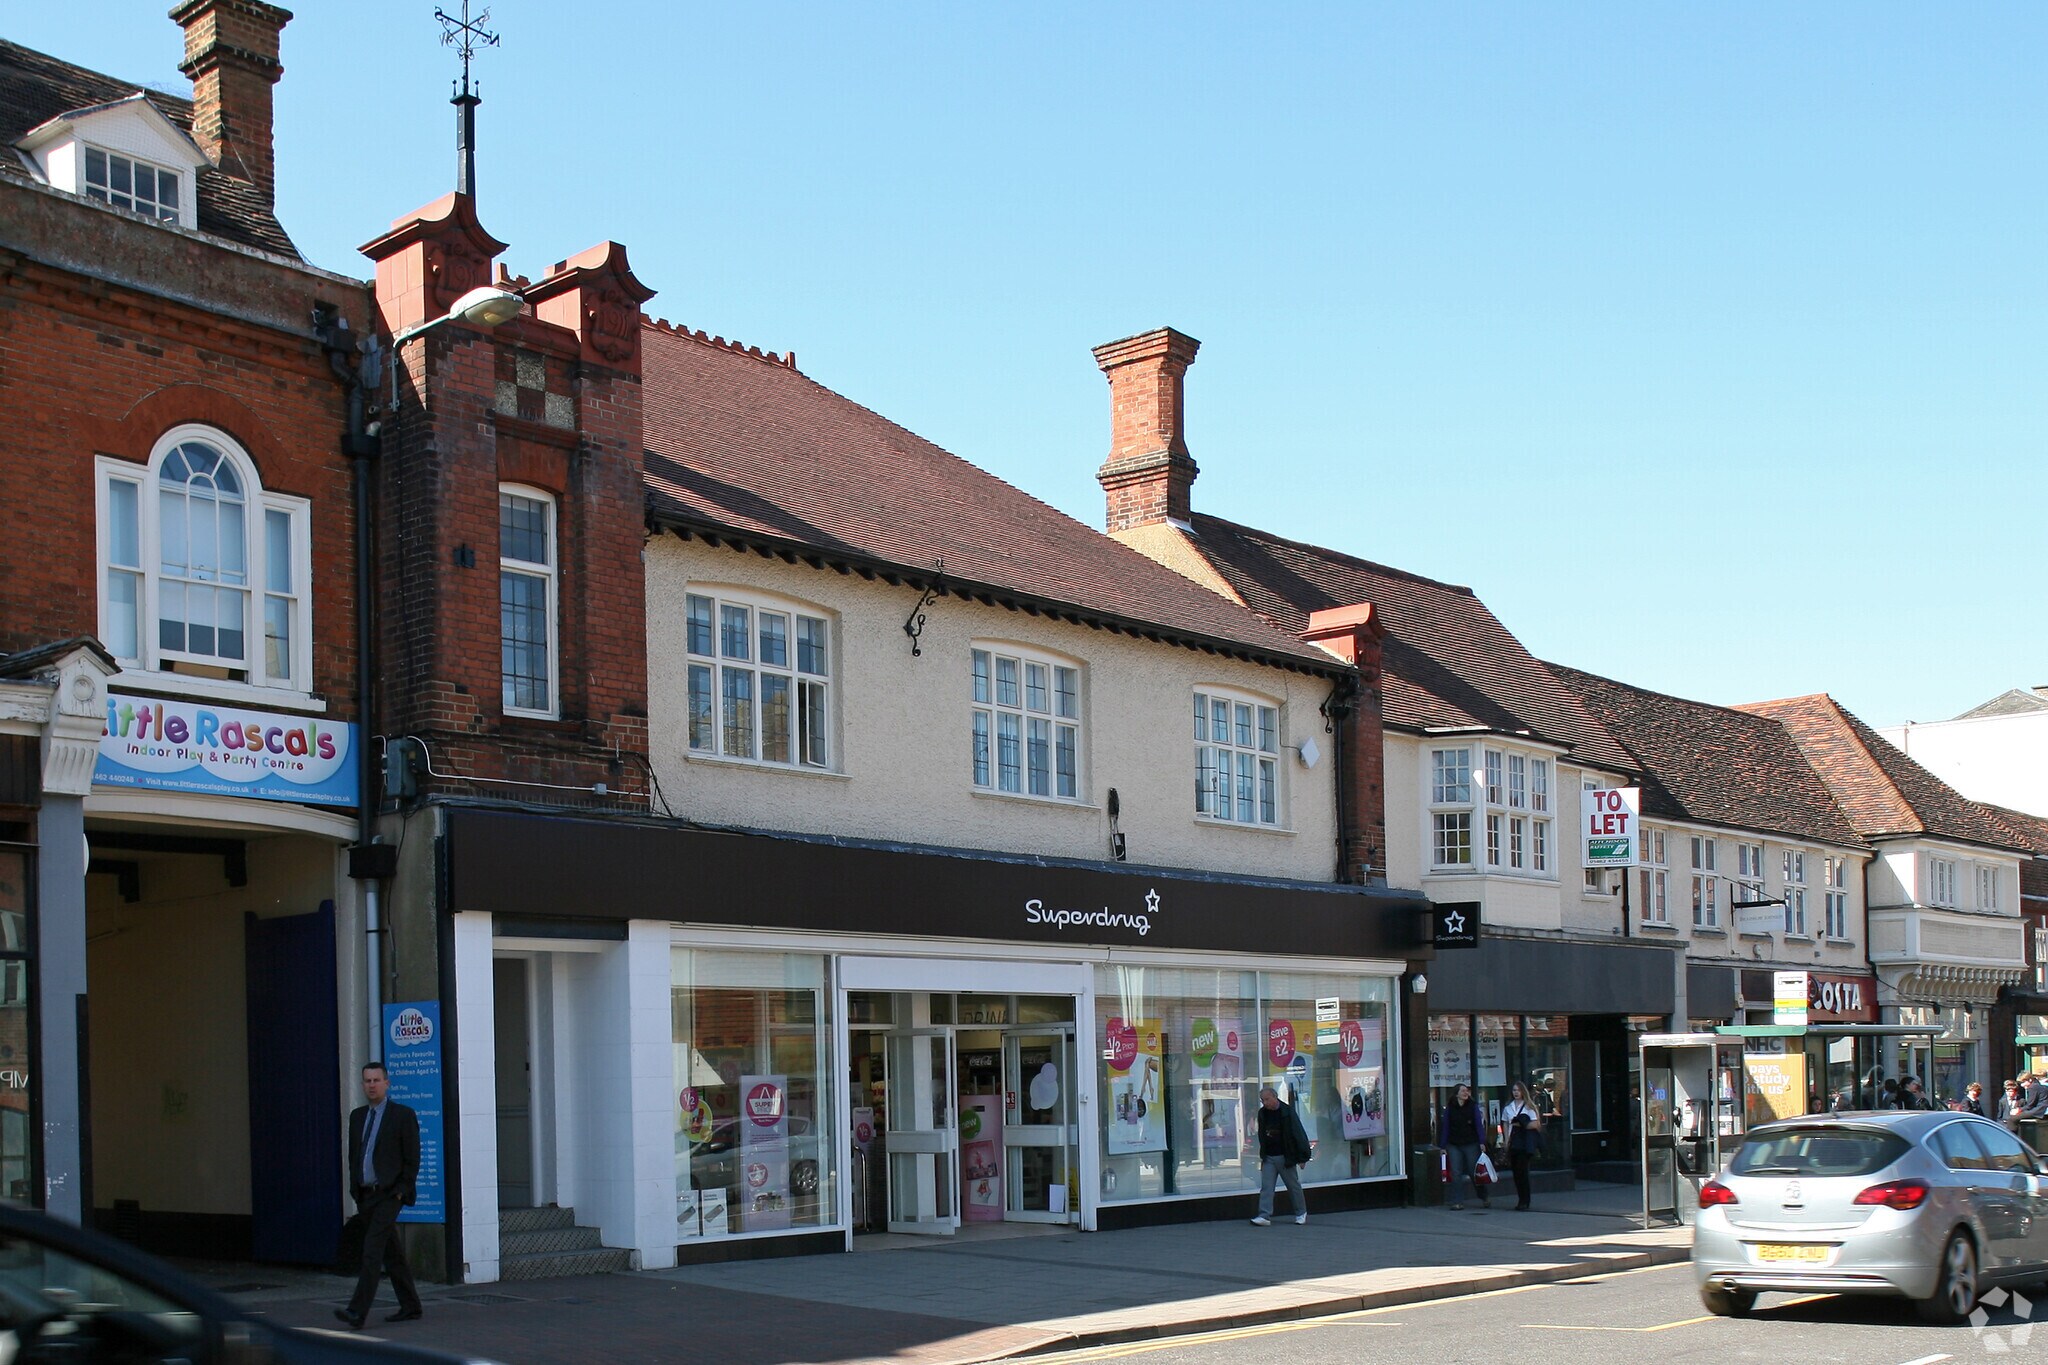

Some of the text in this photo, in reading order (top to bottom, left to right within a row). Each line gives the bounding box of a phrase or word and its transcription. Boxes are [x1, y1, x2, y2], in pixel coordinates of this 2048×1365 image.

[102, 698, 336, 760] ittle Rascals
[127, 743, 304, 771] Indoor Play & Party Centre
[145, 777, 161, 786] Visit
[1593, 790, 1622, 812] TO
[1590, 813, 1629, 835] LET
[1025, 899, 1151, 936] Superdrug
[1814, 981, 1862, 1014] OSTA
[400, 1013, 423, 1026] Little
[395, 1023, 430, 1037] Rascals
[1270, 1026, 1289, 1039] save
[1192, 1030, 1214, 1051] new
[1275, 1039, 1289, 1057] £2
[1341, 1029, 1360, 1055] 1/2
[1346, 1053, 1359, 1063] Price
[1749, 1065, 1781, 1076] pays
[1754, 1073, 1791, 1087] study
